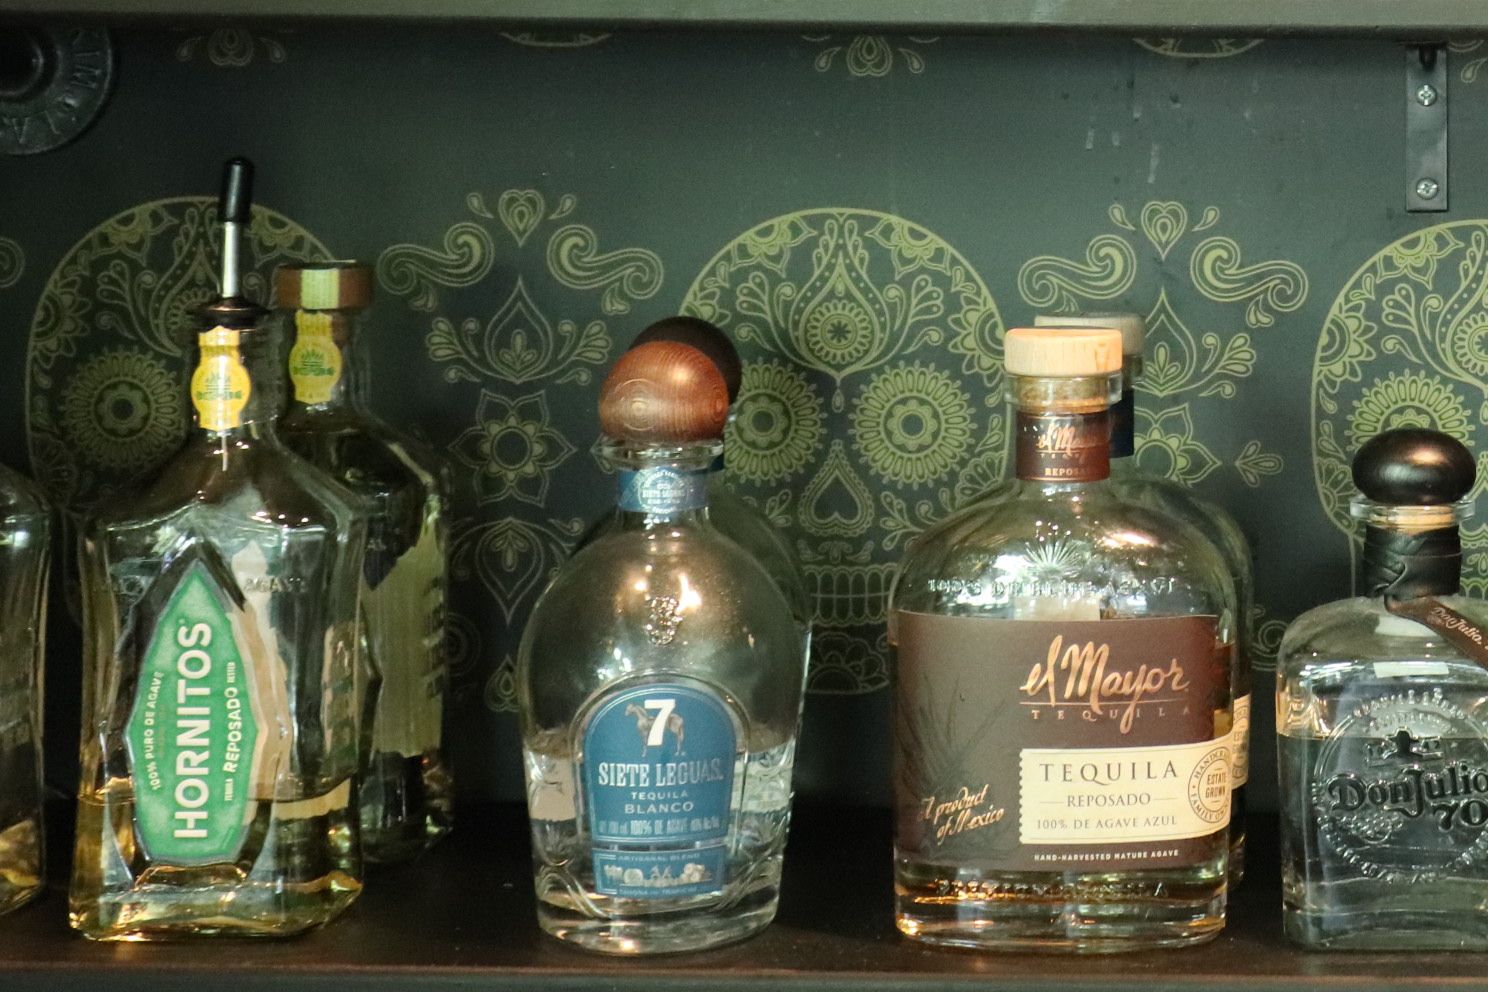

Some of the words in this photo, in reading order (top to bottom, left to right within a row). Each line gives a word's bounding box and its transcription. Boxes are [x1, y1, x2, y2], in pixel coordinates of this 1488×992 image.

[147, 671, 164, 709] AGAVE
[1060, 640, 1190, 735] Mayor
[145, 710, 155, 726] DE
[644, 698, 676, 746] 7
[1030, 705, 1190, 722] TEQUILA
[173, 622, 212, 839] HORNITOS
[223, 686, 242, 773] REPOSADO
[144, 728, 155, 759] PURO
[147, 761, 161, 791] 100%
[598, 762, 650, 787] SIETE
[655, 759, 721, 787] LEGUAS
[1038, 759, 1179, 786] TEQUILA
[1206, 771, 1227, 786] ESTATE
[631, 790, 688, 801] TEQUILA
[933, 783, 990, 825] product
[1066, 792, 1151, 808] REPOSADO
[1205, 785, 1226, 799] GROWN
[624, 801, 694, 815] BLANCO
[936, 815, 954, 846] of
[948, 804, 1005, 836] Mexico
[1036, 818, 1067, 830] 100%
[1073, 817, 1091, 829] DE
[1096, 816, 1140, 829] AGAVE
[1143, 815, 1177, 827] AZUL
[1034, 852, 1111, 861] HAND-HARVESTED
[1114, 851, 1147, 859] MATURE
[1150, 849, 1179, 858] AGAVE
